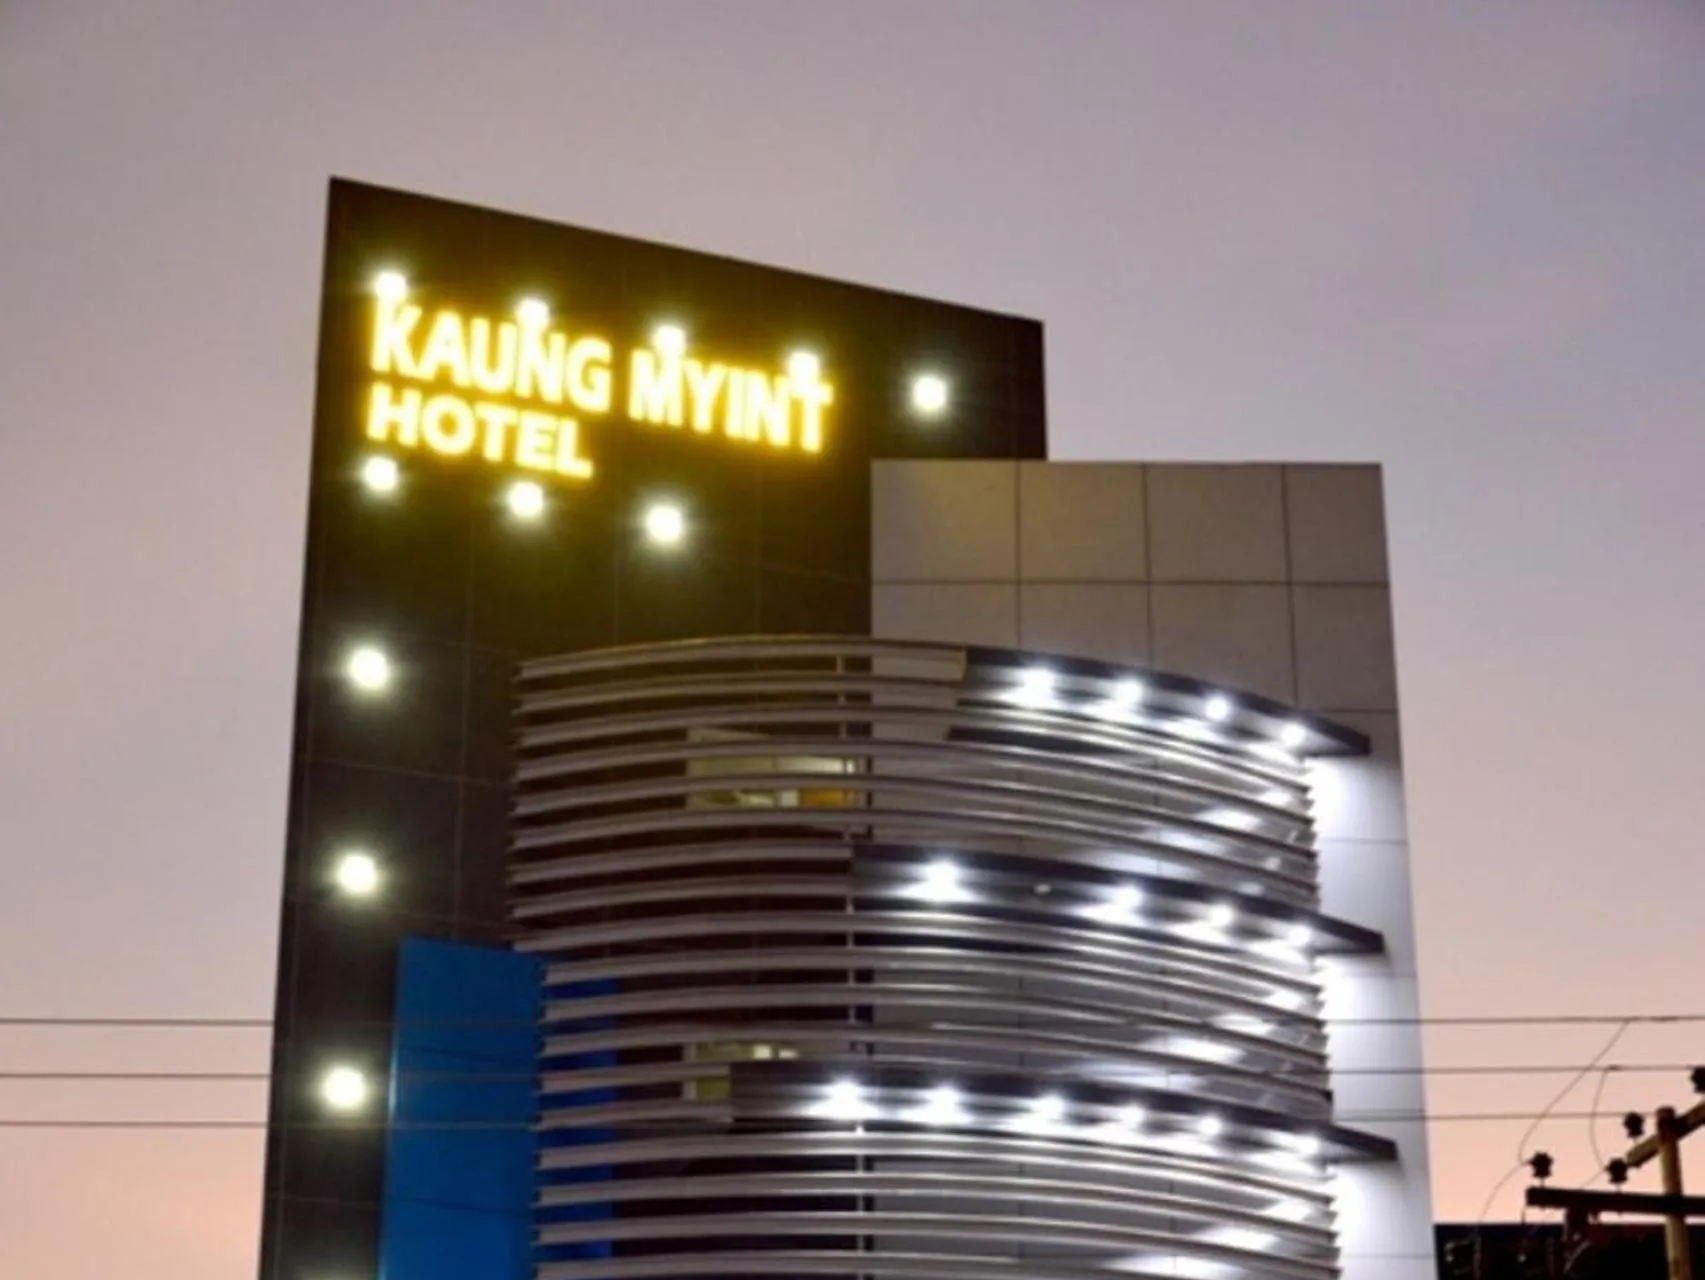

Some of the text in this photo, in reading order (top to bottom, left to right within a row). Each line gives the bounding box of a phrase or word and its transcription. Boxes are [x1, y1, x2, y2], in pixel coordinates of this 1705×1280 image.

[366, 384, 594, 479] HOTEL
[369, 299, 833, 453] KAUNG MYINT
